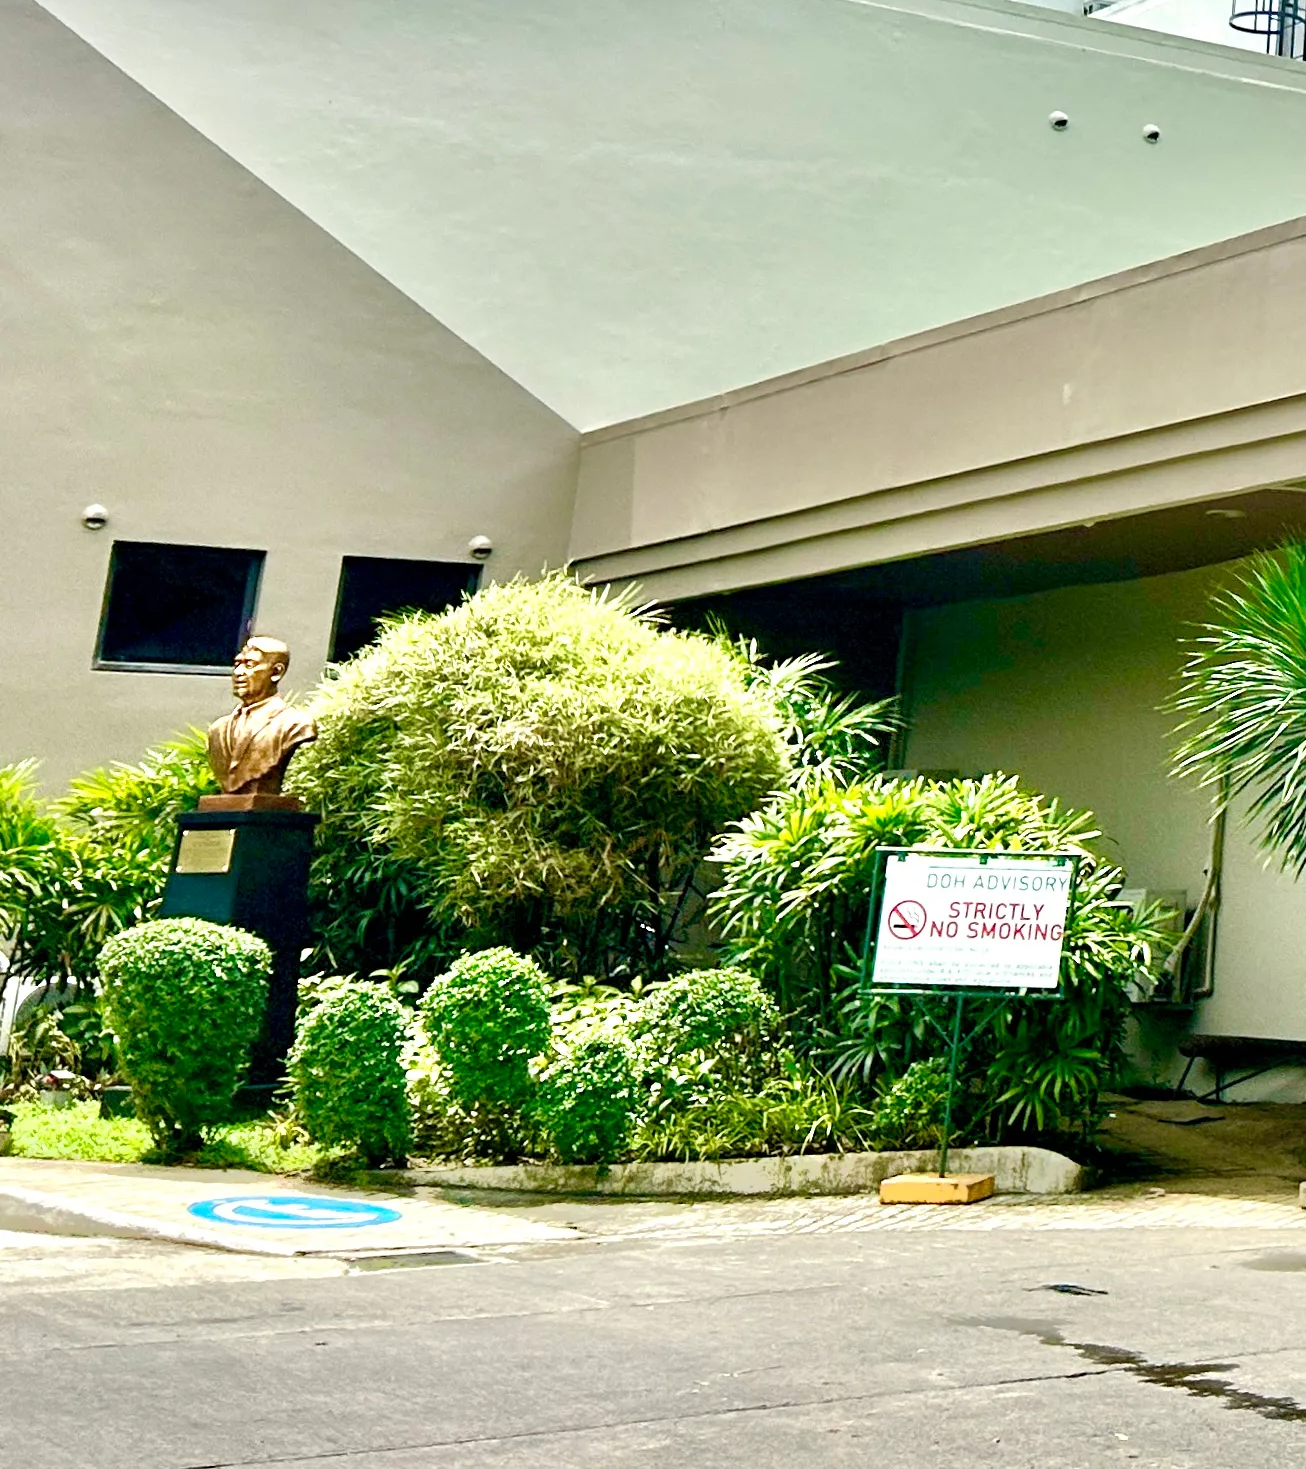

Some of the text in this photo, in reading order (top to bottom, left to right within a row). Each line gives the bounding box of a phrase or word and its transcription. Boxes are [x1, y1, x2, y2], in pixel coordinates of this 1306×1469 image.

[927, 873, 1069, 892] DOH ADVISORY
[949, 901, 1045, 921] STRICTLY
[930, 920, 1064, 941] NO SMOKING
